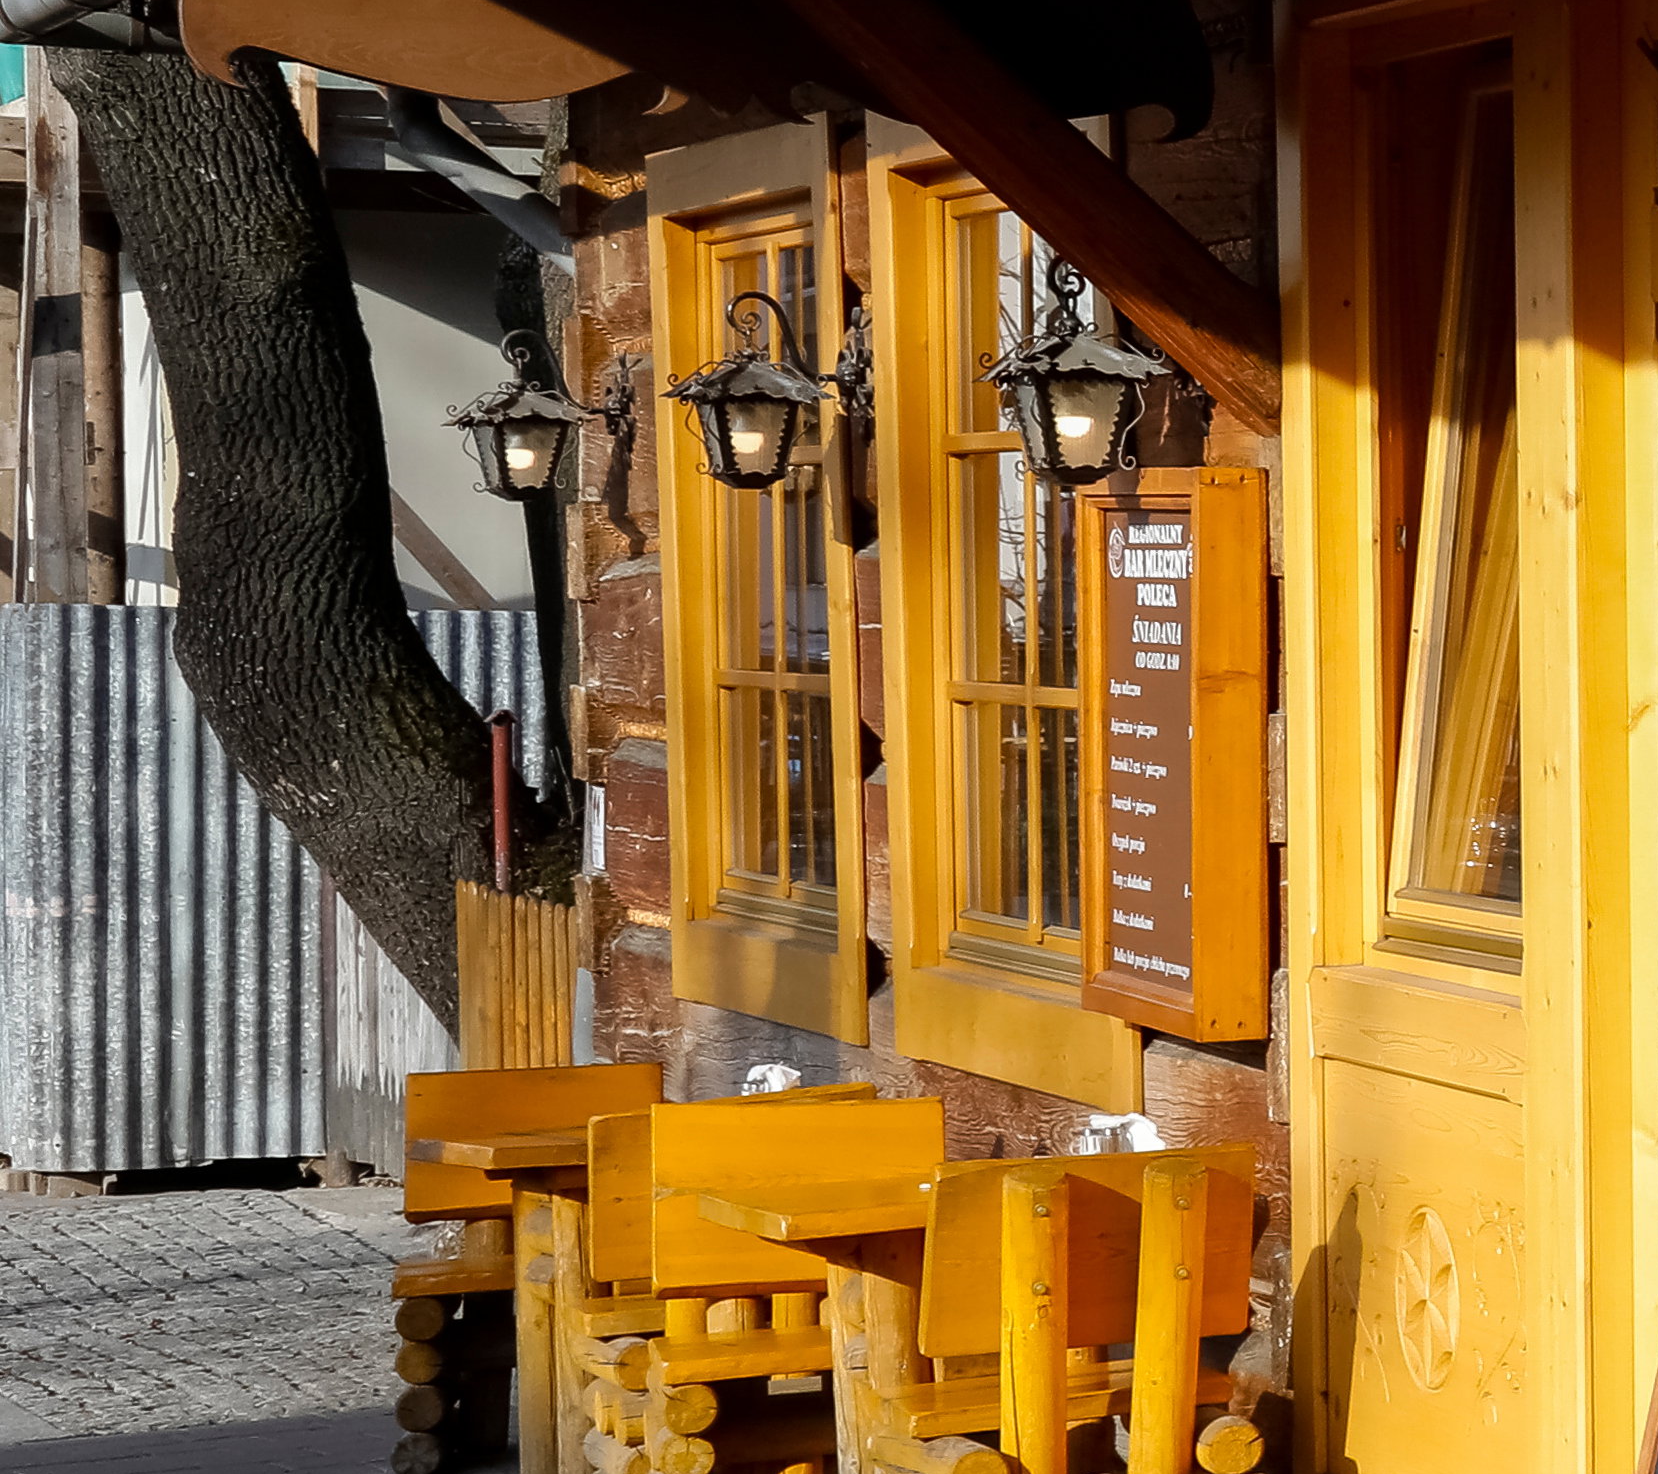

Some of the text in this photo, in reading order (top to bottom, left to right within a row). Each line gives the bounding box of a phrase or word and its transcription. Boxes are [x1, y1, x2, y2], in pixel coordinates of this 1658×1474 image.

[1124, 548, 1188, 579] BAR MLECZNY
[1136, 583, 1177, 608] POLECA
